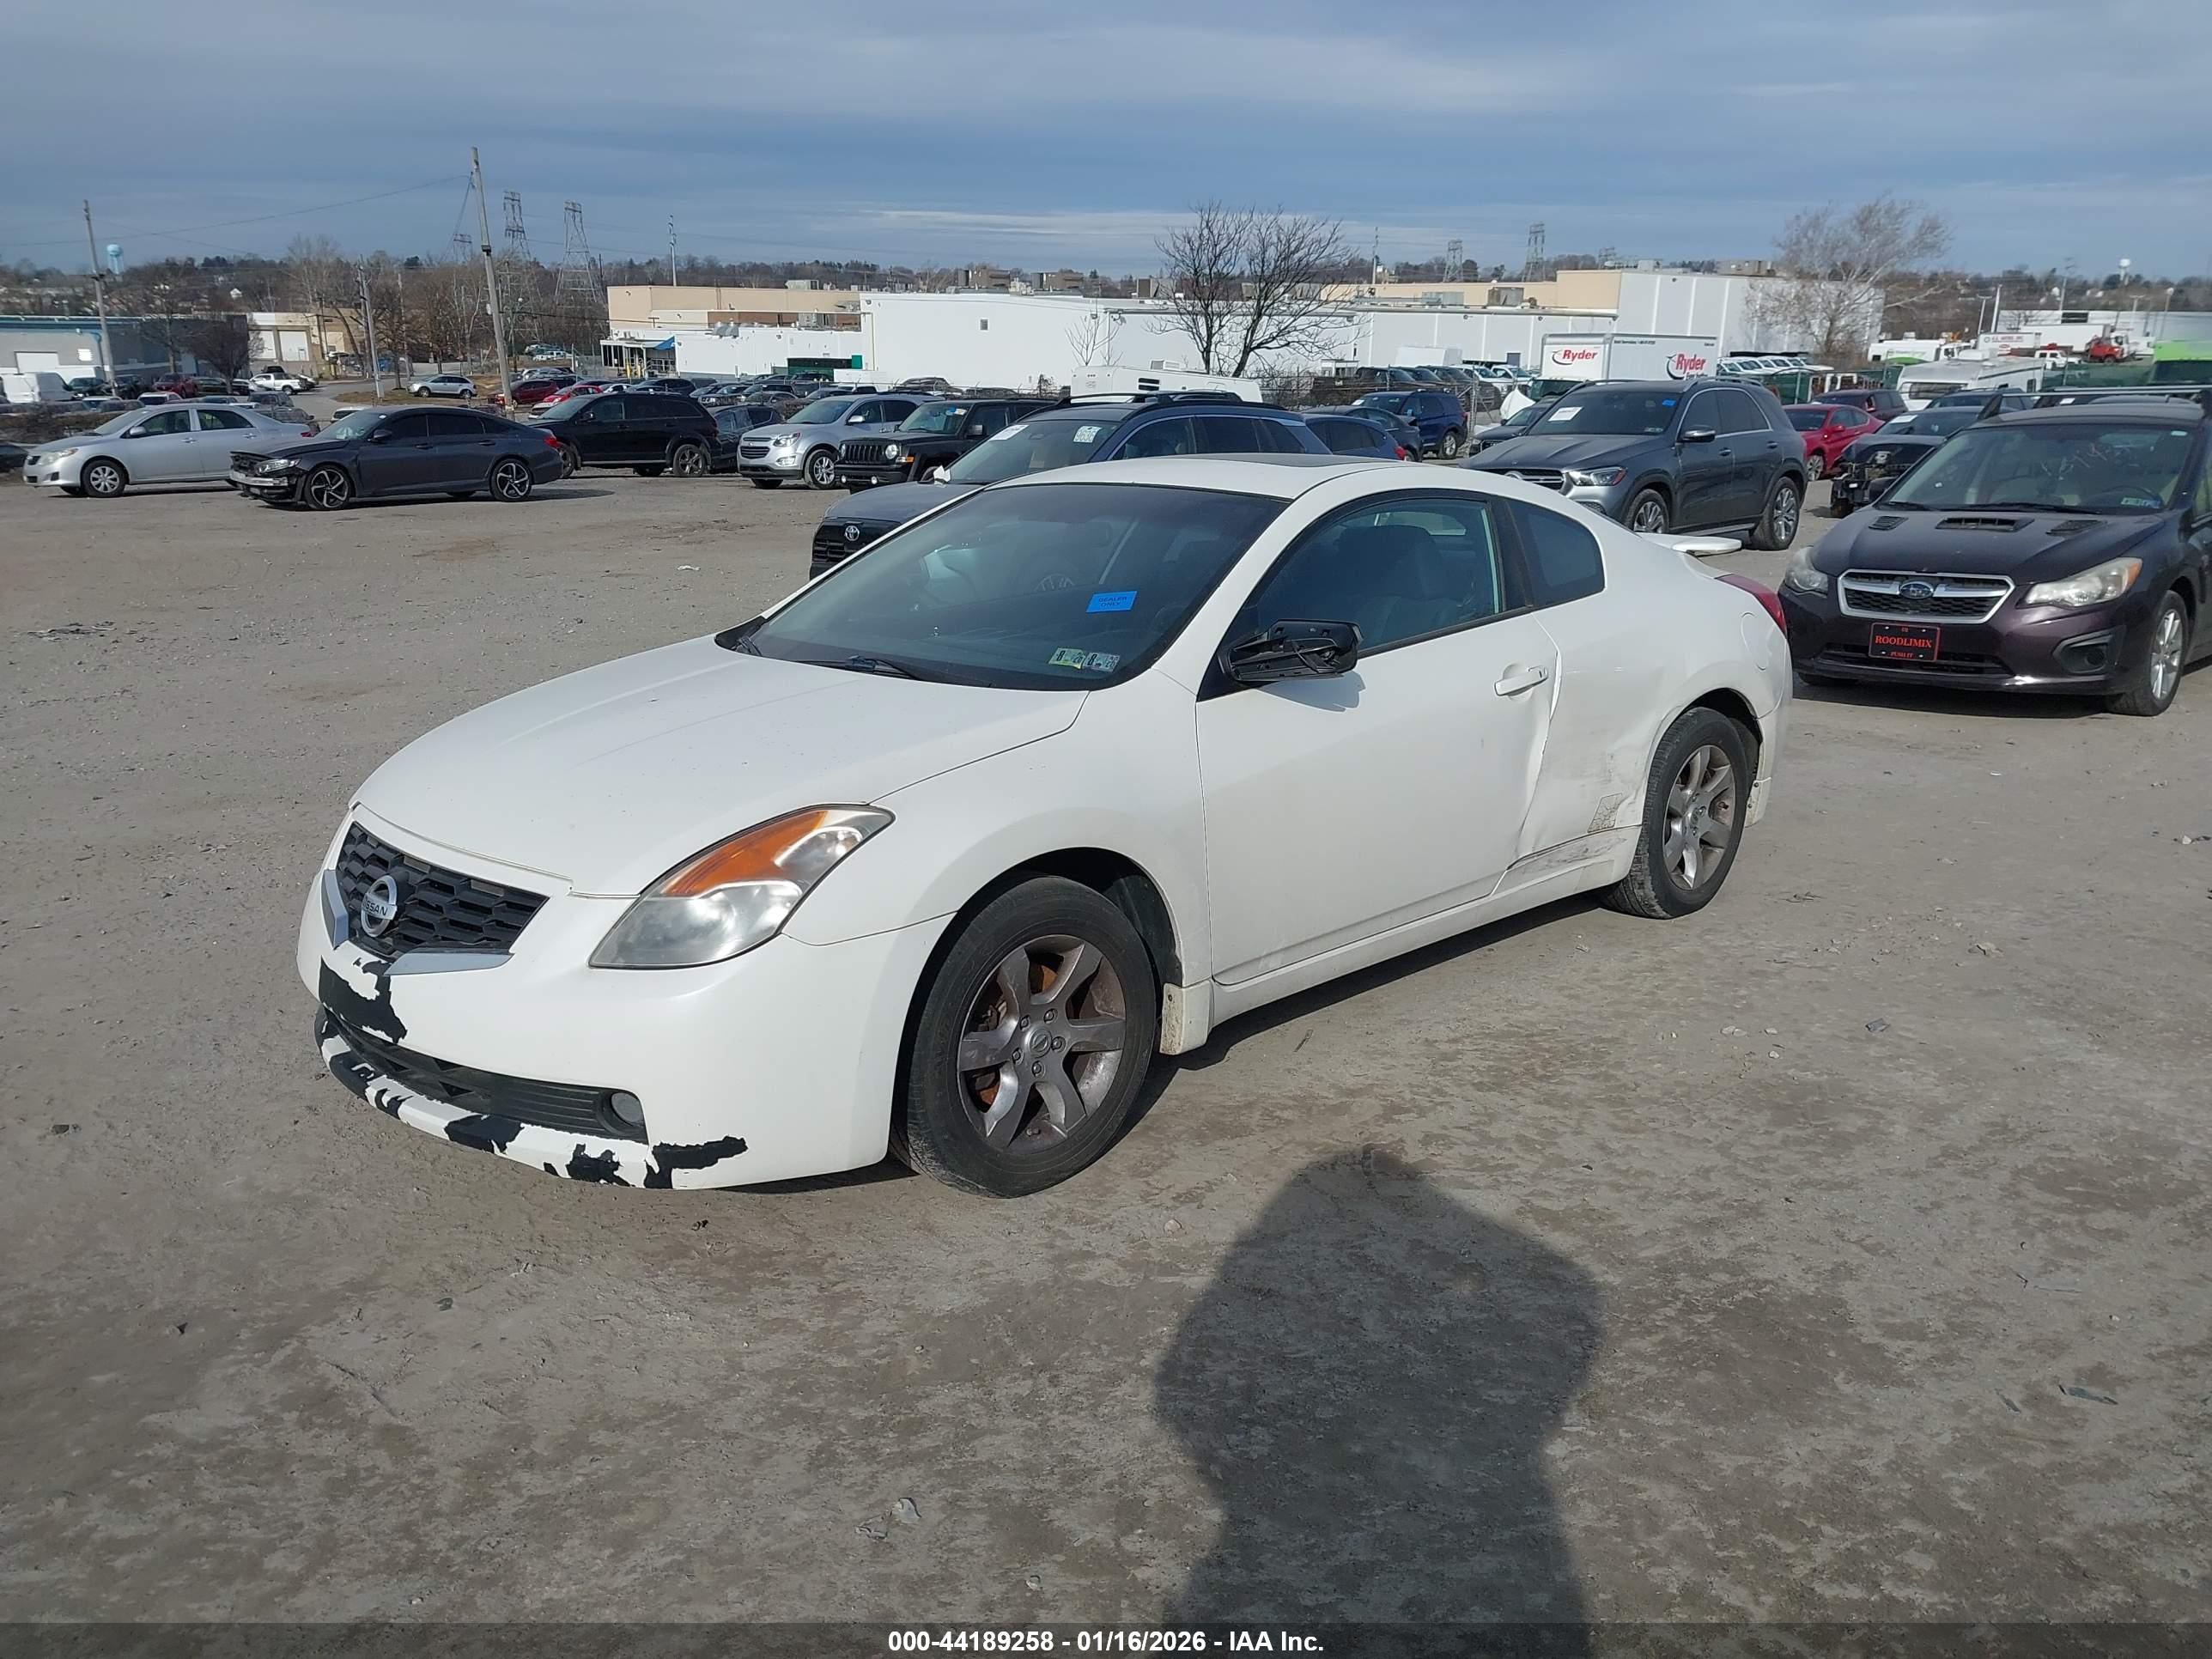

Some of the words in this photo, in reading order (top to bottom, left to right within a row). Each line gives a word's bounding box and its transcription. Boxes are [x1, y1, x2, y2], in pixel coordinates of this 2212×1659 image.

[1562, 349, 1598, 362] Ryder
[1675, 353, 1706, 374] Ryder
[1875, 635, 1931, 647] ROODLIMIX
